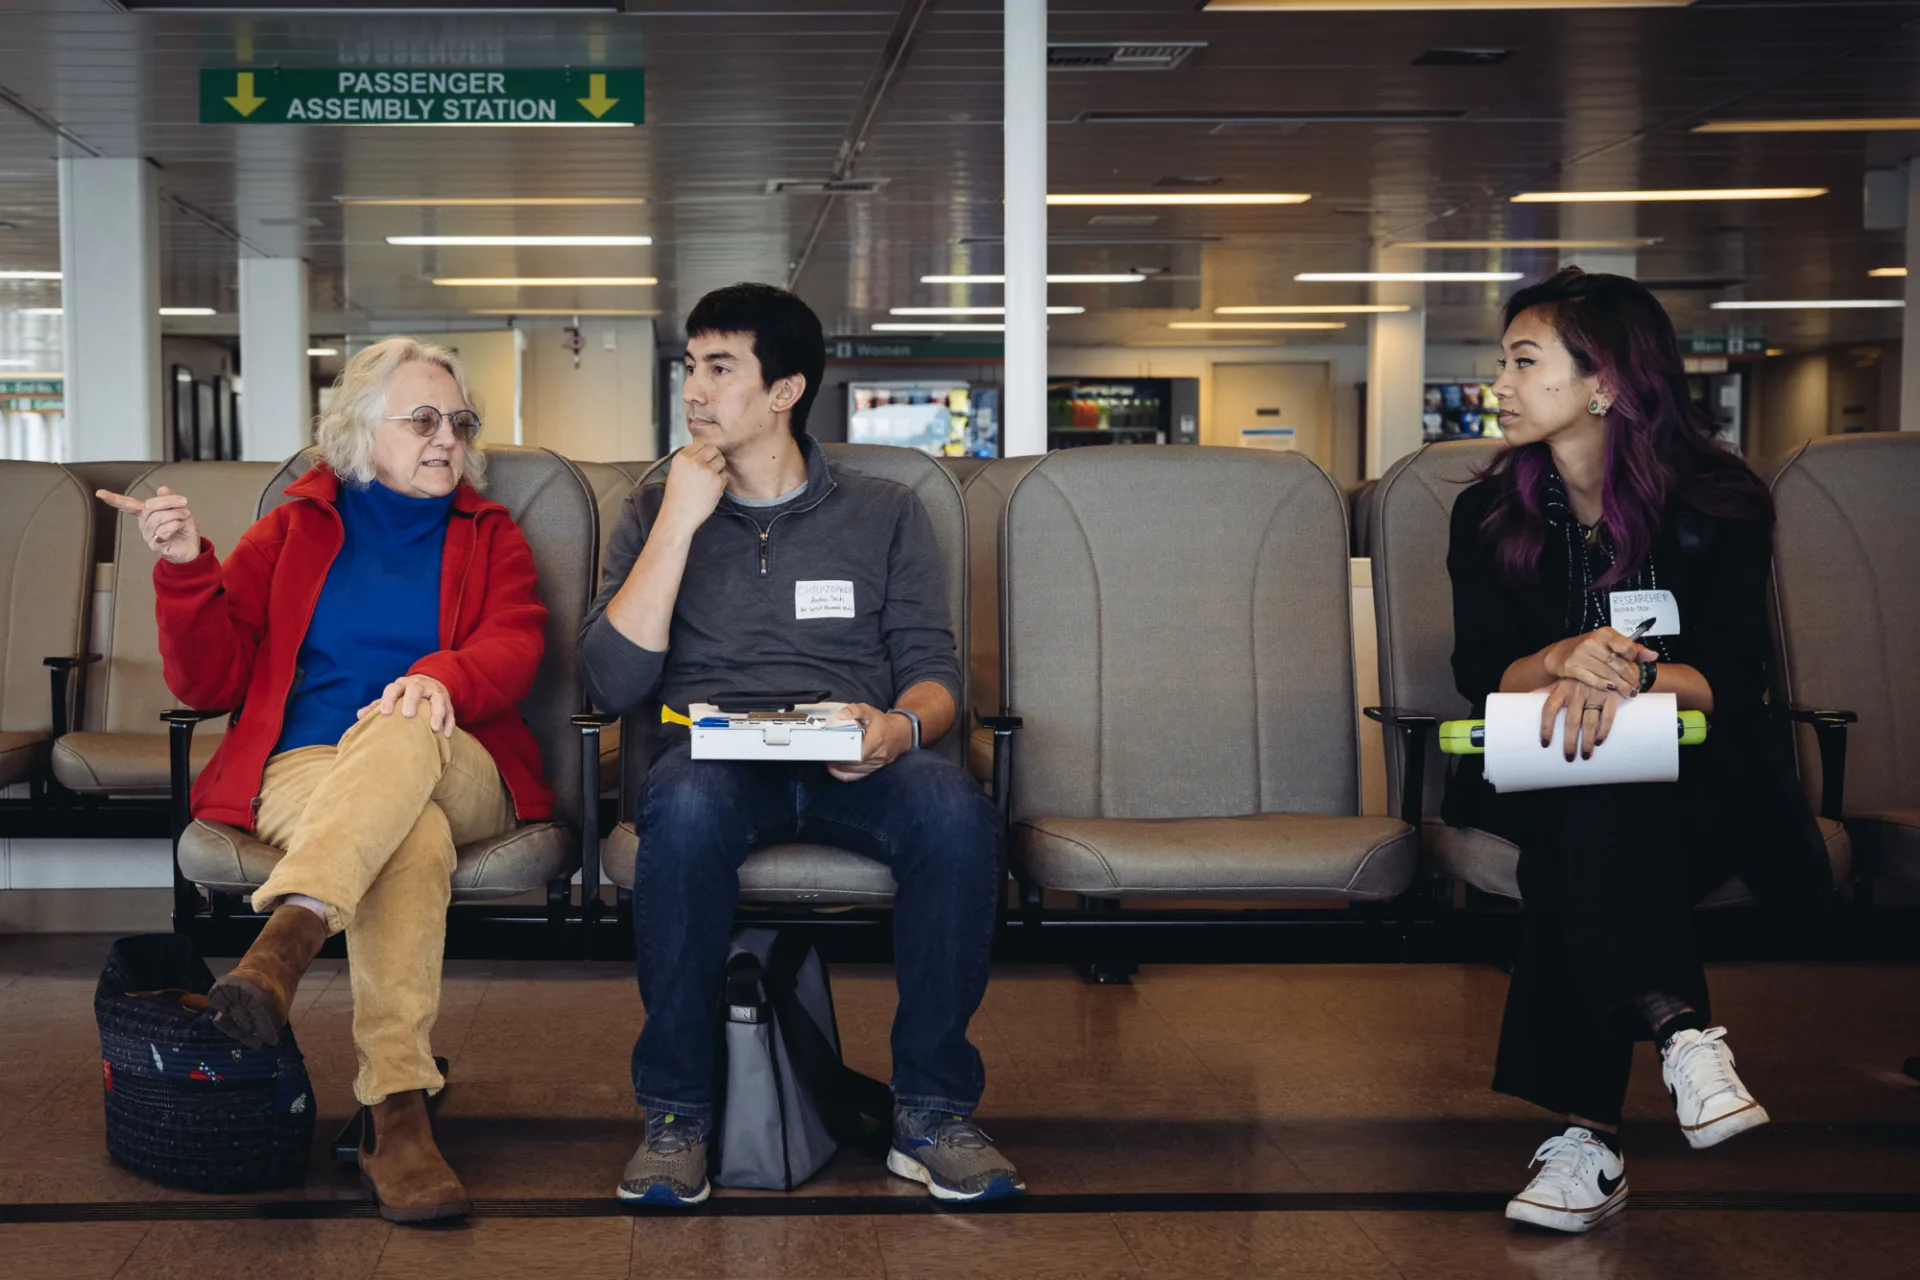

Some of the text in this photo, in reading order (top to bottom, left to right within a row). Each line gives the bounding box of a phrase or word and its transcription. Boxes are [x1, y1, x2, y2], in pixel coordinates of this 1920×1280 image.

[338, 72, 506, 94] PASSENGER
[287, 98, 556, 120] ASSEMBLY STATION
[857, 343, 911, 356] Women
[1693, 340, 1723, 353] Men
[1612, 593, 1668, 605] RESEARCHER
